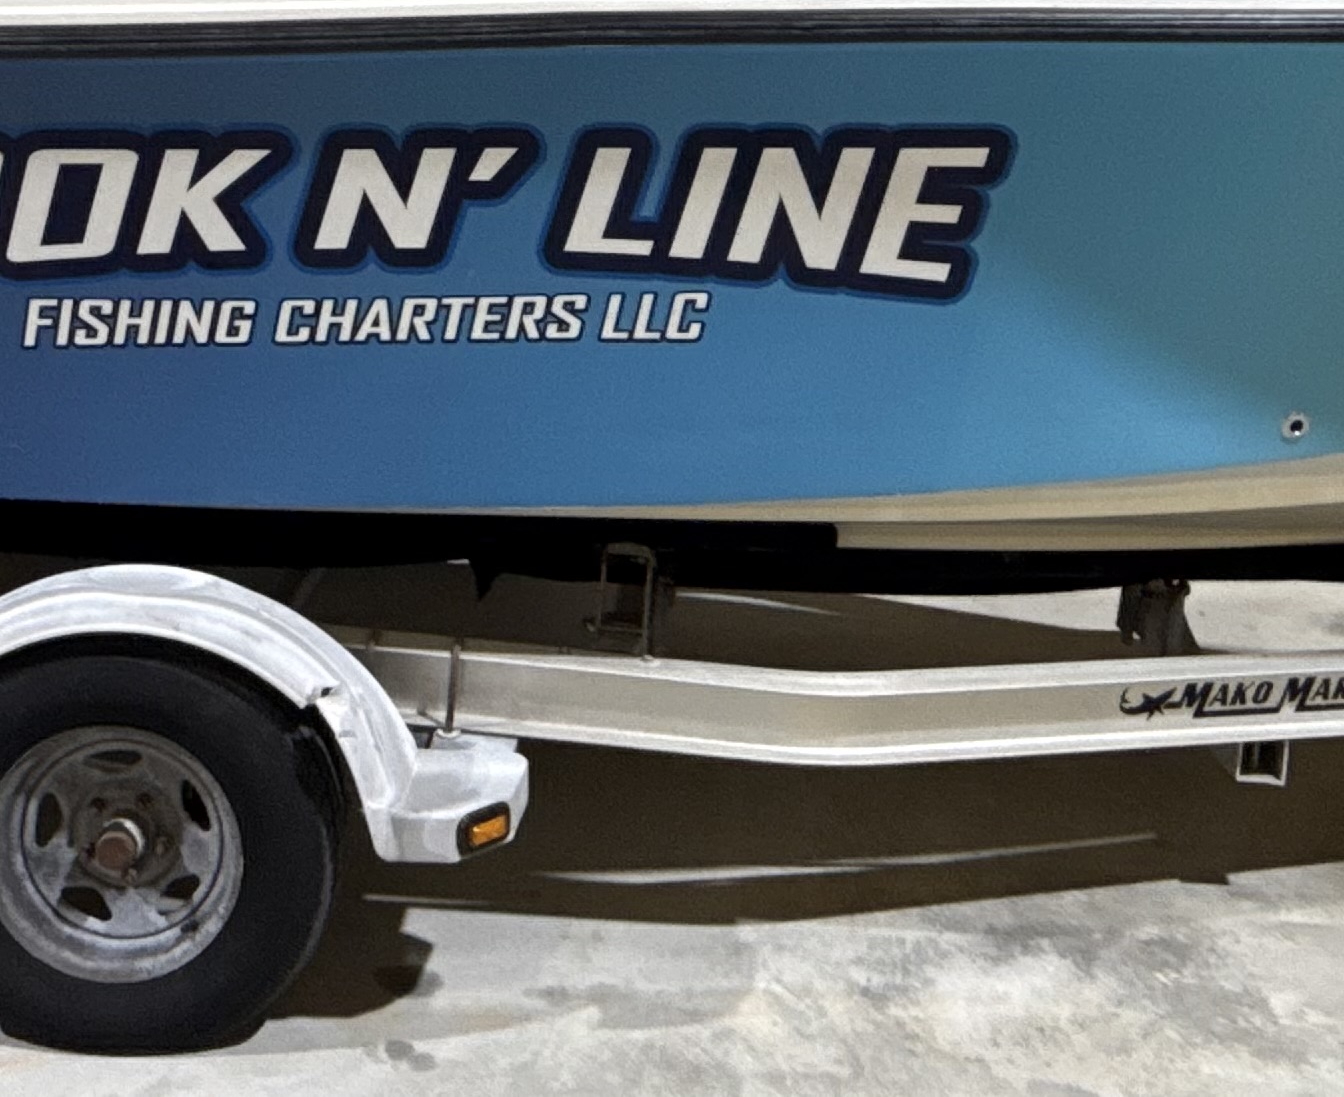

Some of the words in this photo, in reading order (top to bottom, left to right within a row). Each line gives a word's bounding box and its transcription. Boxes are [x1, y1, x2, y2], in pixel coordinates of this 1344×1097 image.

[563, 147, 990, 283] LINE
[22, 299, 257, 348] FISHING
[273, 295, 586, 346] CHARTERS
[599, 292, 711, 341] LLC
[1179, 680, 1279, 717] MAKO
